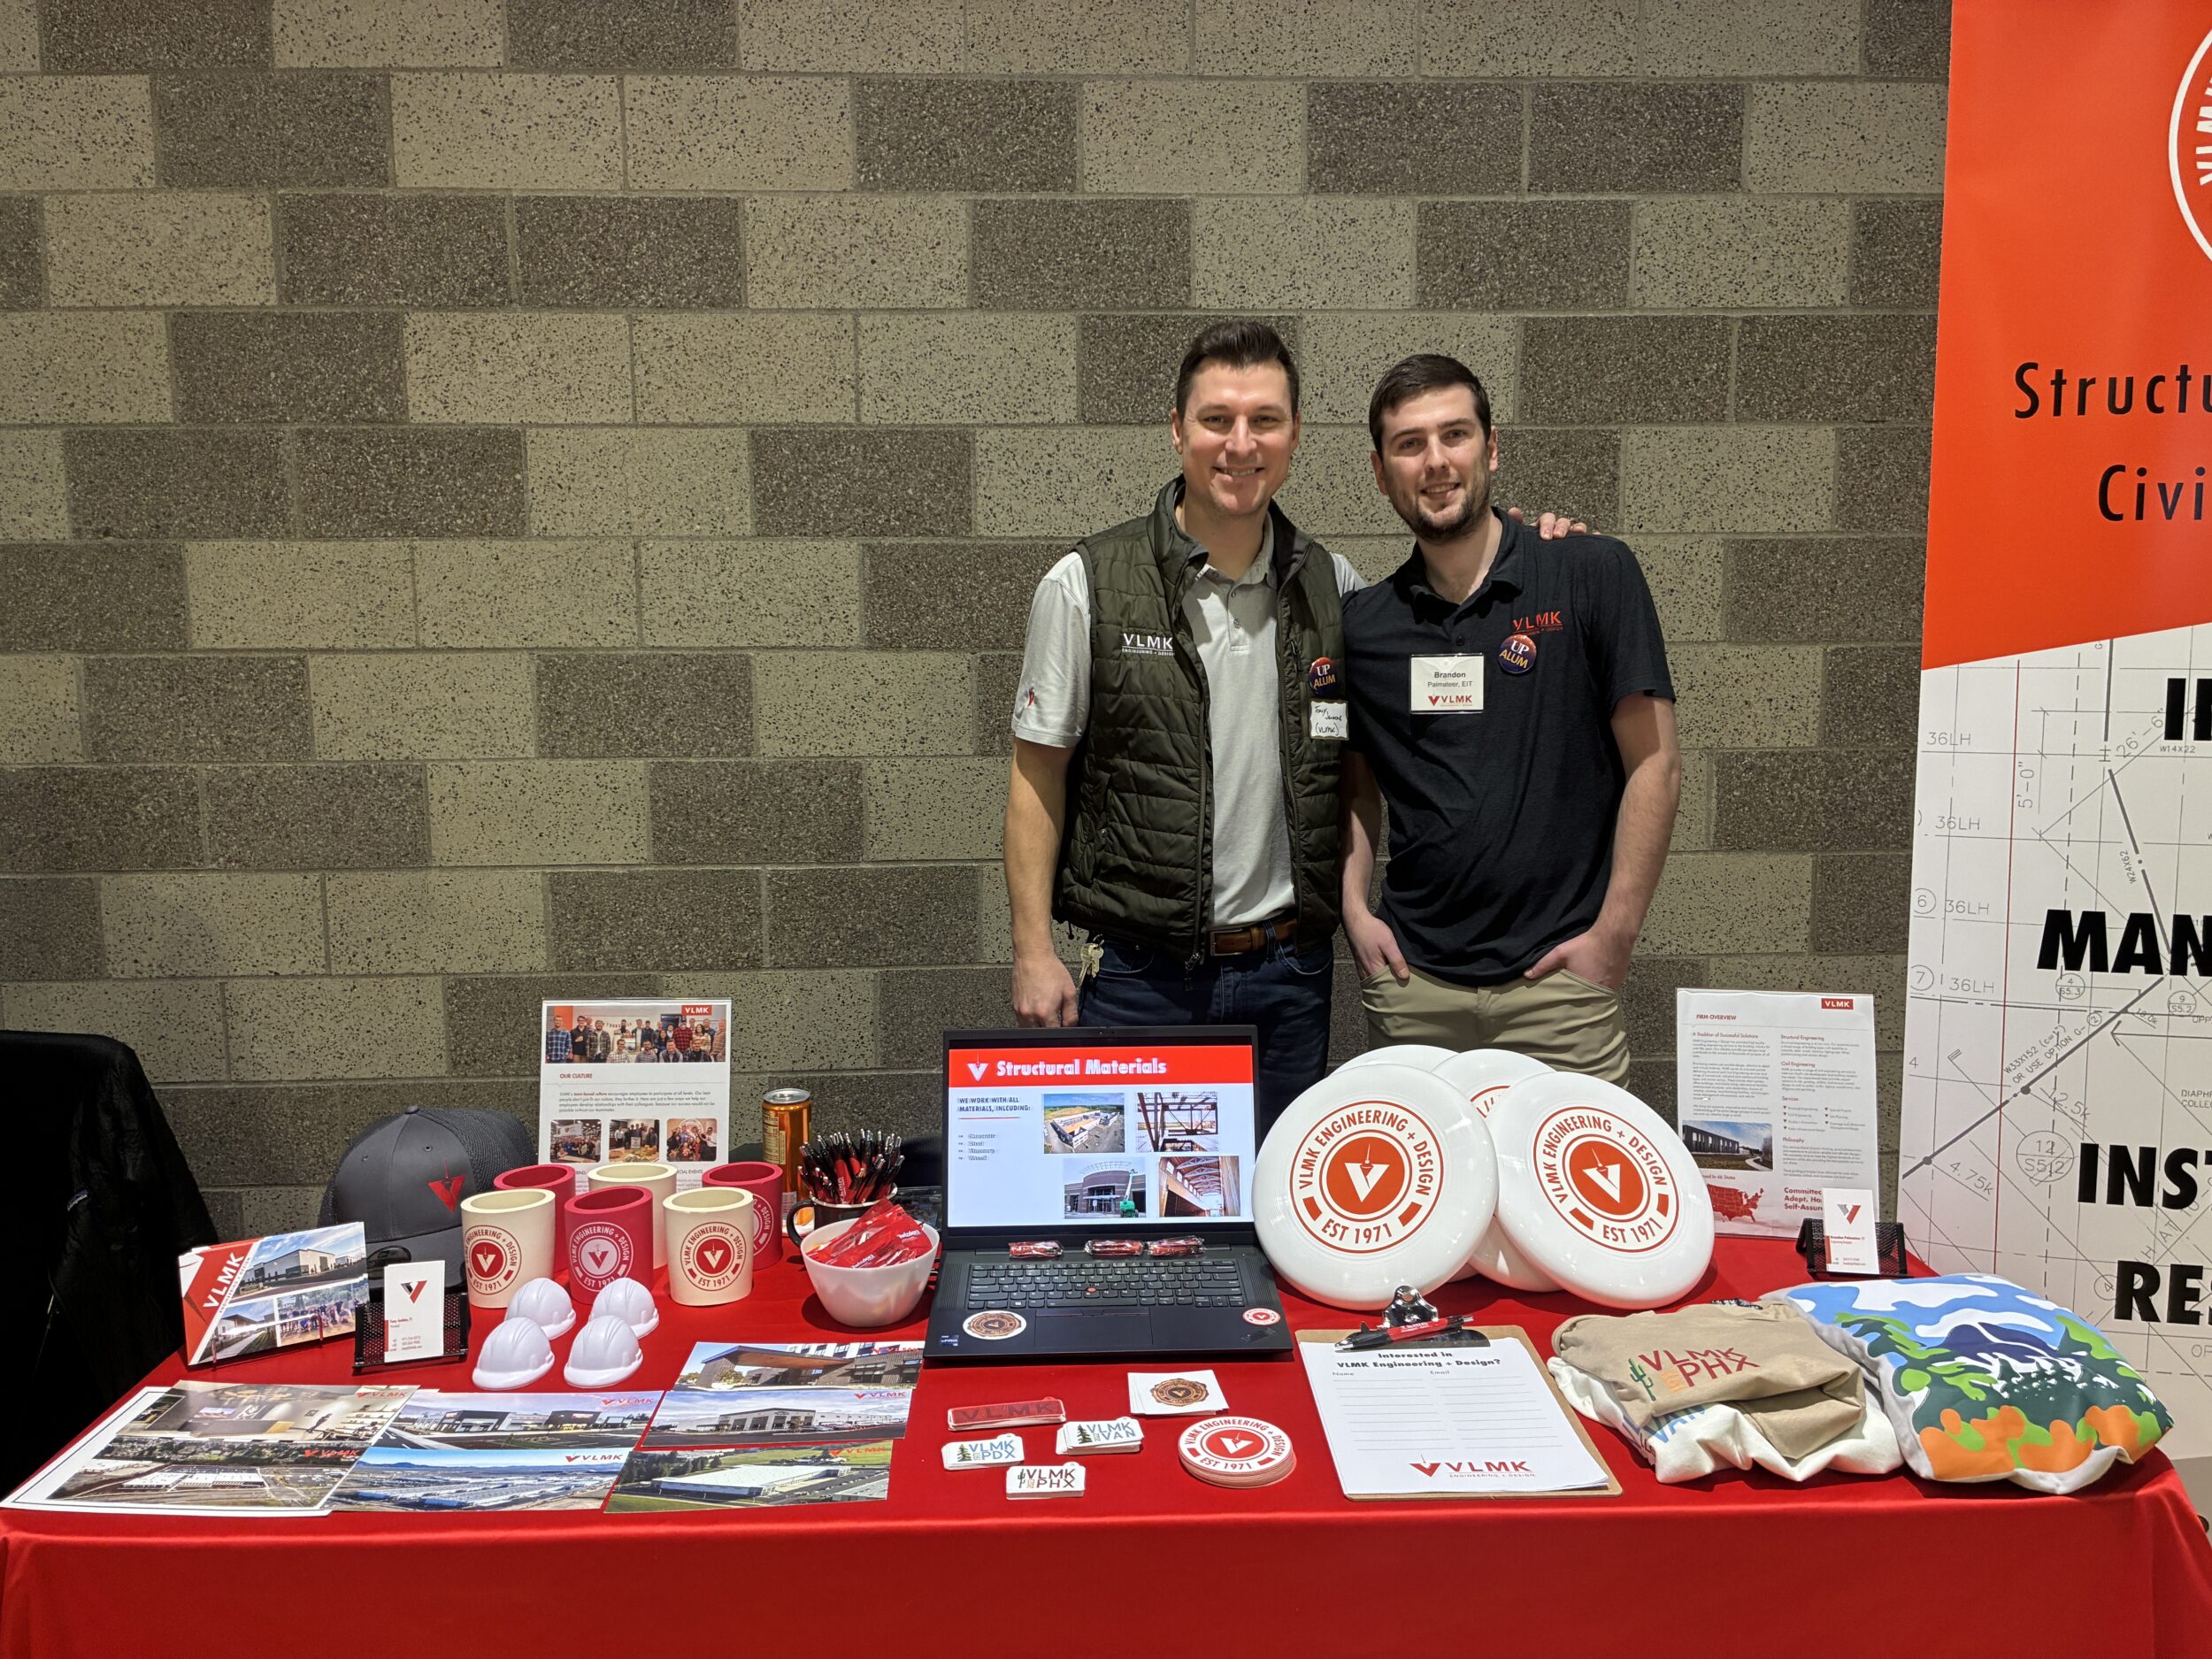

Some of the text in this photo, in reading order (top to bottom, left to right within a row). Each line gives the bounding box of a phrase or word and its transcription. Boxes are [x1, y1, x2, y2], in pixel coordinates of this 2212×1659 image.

[1514, 611, 1562, 630] VLMK
[1123, 633, 1173, 650] VLMK
[1510, 640, 1530, 654] UP
[1499, 649, 1528, 669] ALUM
[1317, 664, 1331, 676] UP
[1314, 674, 1336, 689] ALUM
[1441, 695, 1472, 703] VLMK
[1926, 732, 1970, 746] 36LH
[1935, 816, 1980, 830] 36LH
[1917, 895, 1927, 908] 6
[1945, 899, 1989, 915] 36LH
[2037, 909, 2212, 977] MAN
[1916, 972, 1925, 984] 7
[1949, 977, 1994, 994] 36LH
[996, 1057, 1167, 1077] Structural Materials
[2003, 1046, 2039, 1074] W33X152
[2025, 1058, 2044, 1074] USE
[1542, 1115, 1612, 1158] ENGINEERING
[1298, 1148, 1321, 1190] VLMK
[1314, 1110, 1409, 1148] ENGINEERING
[1413, 1140, 1434, 1196] DESIGN
[1628, 1136, 1668, 1186] DESIGN
[1545, 1161, 1569, 1203] VLMK
[1949, 1162, 1993, 1195] 4.75k
[1785, 1195, 1809, 1204] Adept.
[761, 1206, 771, 1230] DESIGN
[1321, 1217, 1393, 1244] EST 1971
[1602, 1217, 1663, 1243] EST 1971
[465, 1229, 502, 1246] ENGINEERING
[506, 1240, 518, 1267] DESIGN
[573, 1225, 615, 1244] ENGINEERING
[618, 1236, 630, 1261] DESIGN
[684, 1245, 693, 1266] VLMK
[689, 1225, 730, 1245] ENGINEERING
[733, 1234, 743, 1260] DESIGN
[202, 1252, 245, 1308] VLMK
[472, 1279, 503, 1291] EST 1971
[584, 1277, 595, 1287] EST
[697, 1275, 731, 1287] EST 1971
[2114, 1260, 2212, 1325] RE
[1372, 1361, 1443, 1370] Engineering
[1455, 1358, 1502, 1367] Design?
[1638, 1347, 1747, 1371] VLMK
[1676, 1356, 1761, 1387] PHX
[959, 1402, 1053, 1420] VLMK
[1087, 1422, 1132, 1433] VLMK
[1101, 1430, 1136, 1440] VAN
[1185, 1428, 1203, 1445] VLMK
[1199, 1418, 1270, 1431] ENGINEERING
[1271, 1434, 1286, 1456] DESIGN
[969, 1440, 1016, 1452] VLMK
[981, 1450, 1016, 1461] PDX
[1199, 1457, 1221, 1467] EST
[1026, 1469, 1076, 1480] VLMK
[1445, 1461, 1532, 1472] VLMK
[1036, 1479, 1075, 1488] PHX
